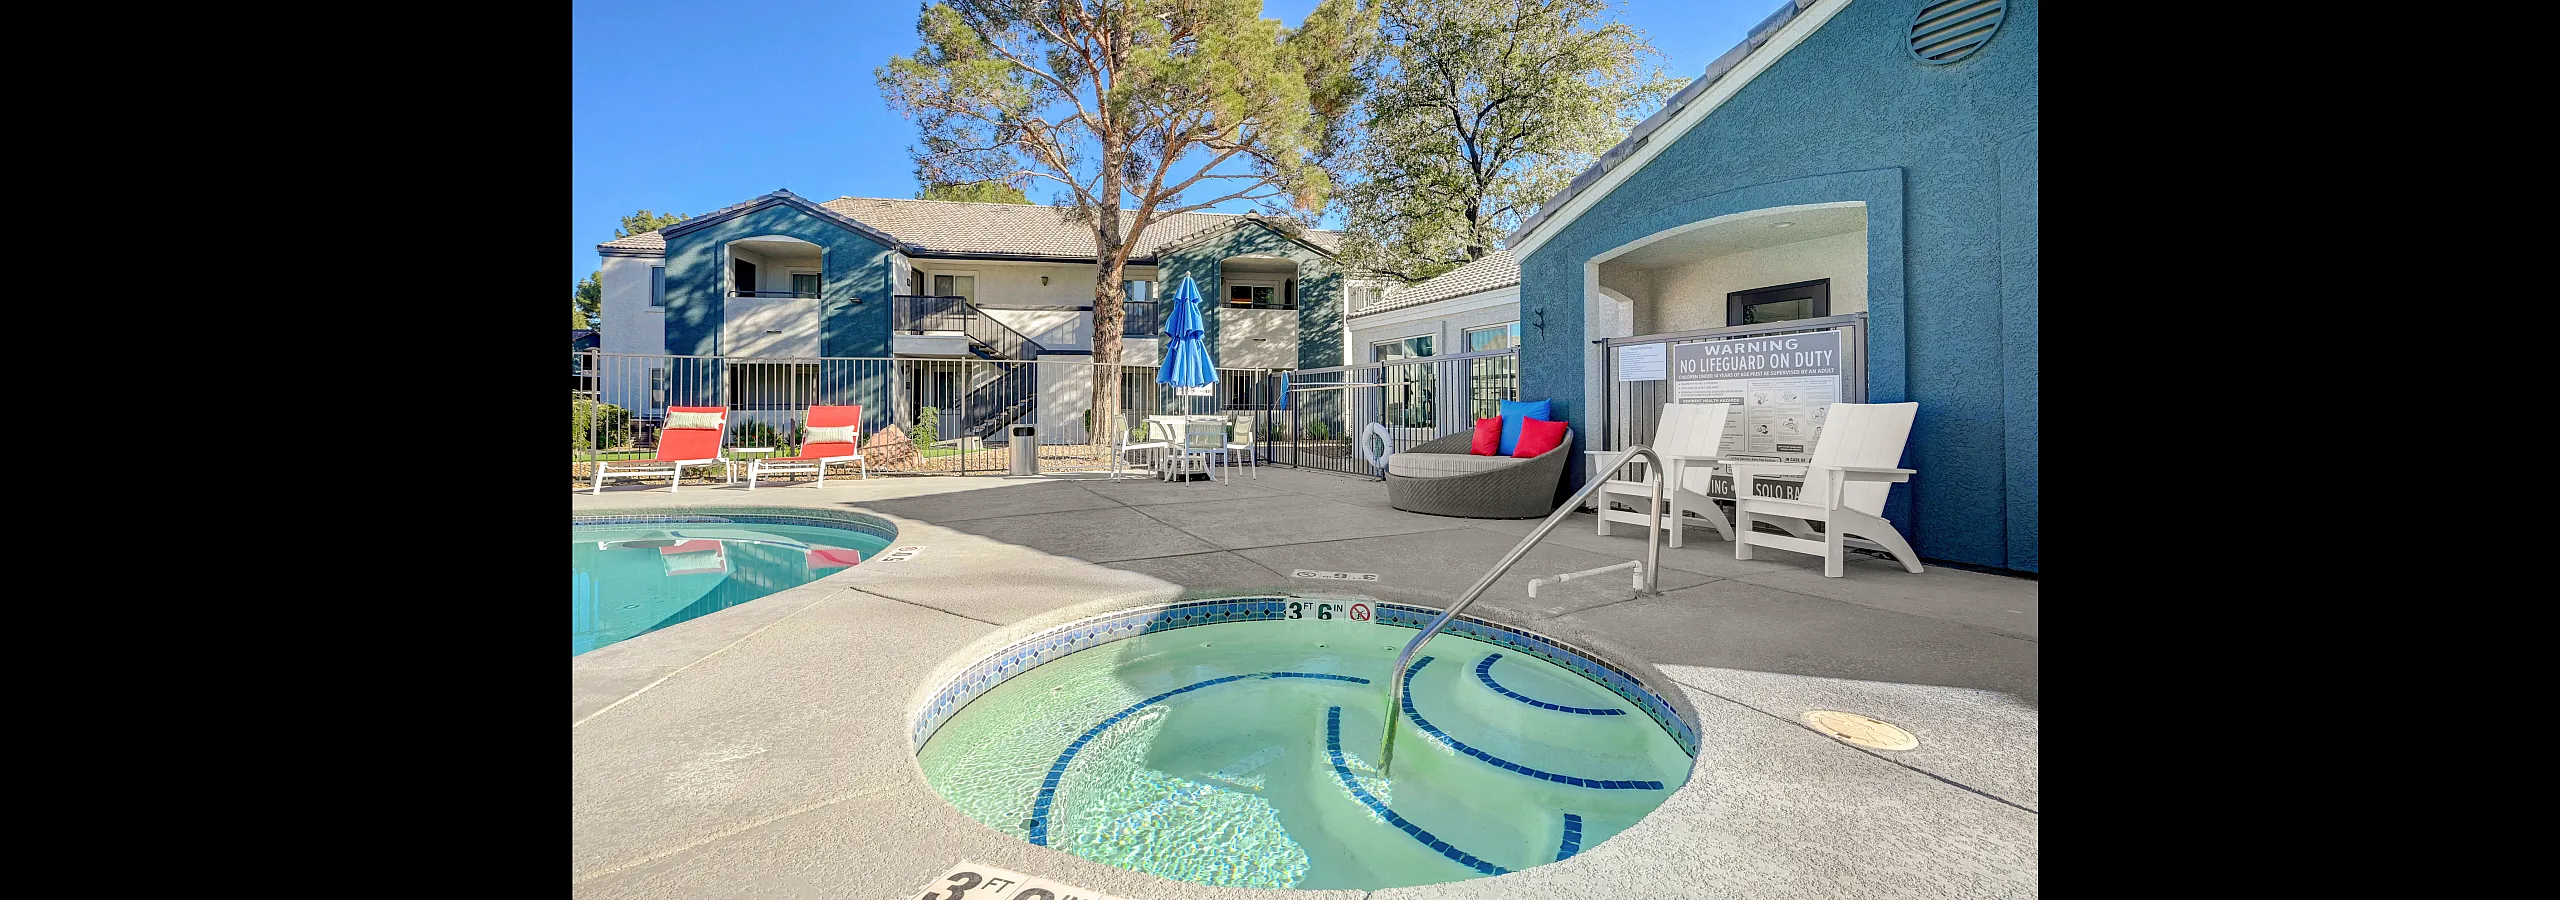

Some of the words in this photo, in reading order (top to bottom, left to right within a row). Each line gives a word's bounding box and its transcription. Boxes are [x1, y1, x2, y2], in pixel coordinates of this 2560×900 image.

[1705, 339, 1798, 355] WARNING
[1680, 359, 1696, 374] NO
[1700, 354, 1765, 373] LIFEGUARD
[1770, 352, 1790, 369] ON
[1795, 350, 1833, 368] DUTY
[1770, 368, 1800, 376] SUPERVISED
[1708, 480, 1727, 495] ING
[1756, 483, 1783, 499] SOLO
[1786, 485, 1800, 500] BA
[1289, 602, 1302, 619] 3
[1318, 604, 1332, 620] 6
[1333, 604, 1343, 612] IN
[980, 877, 1016, 893] FT
